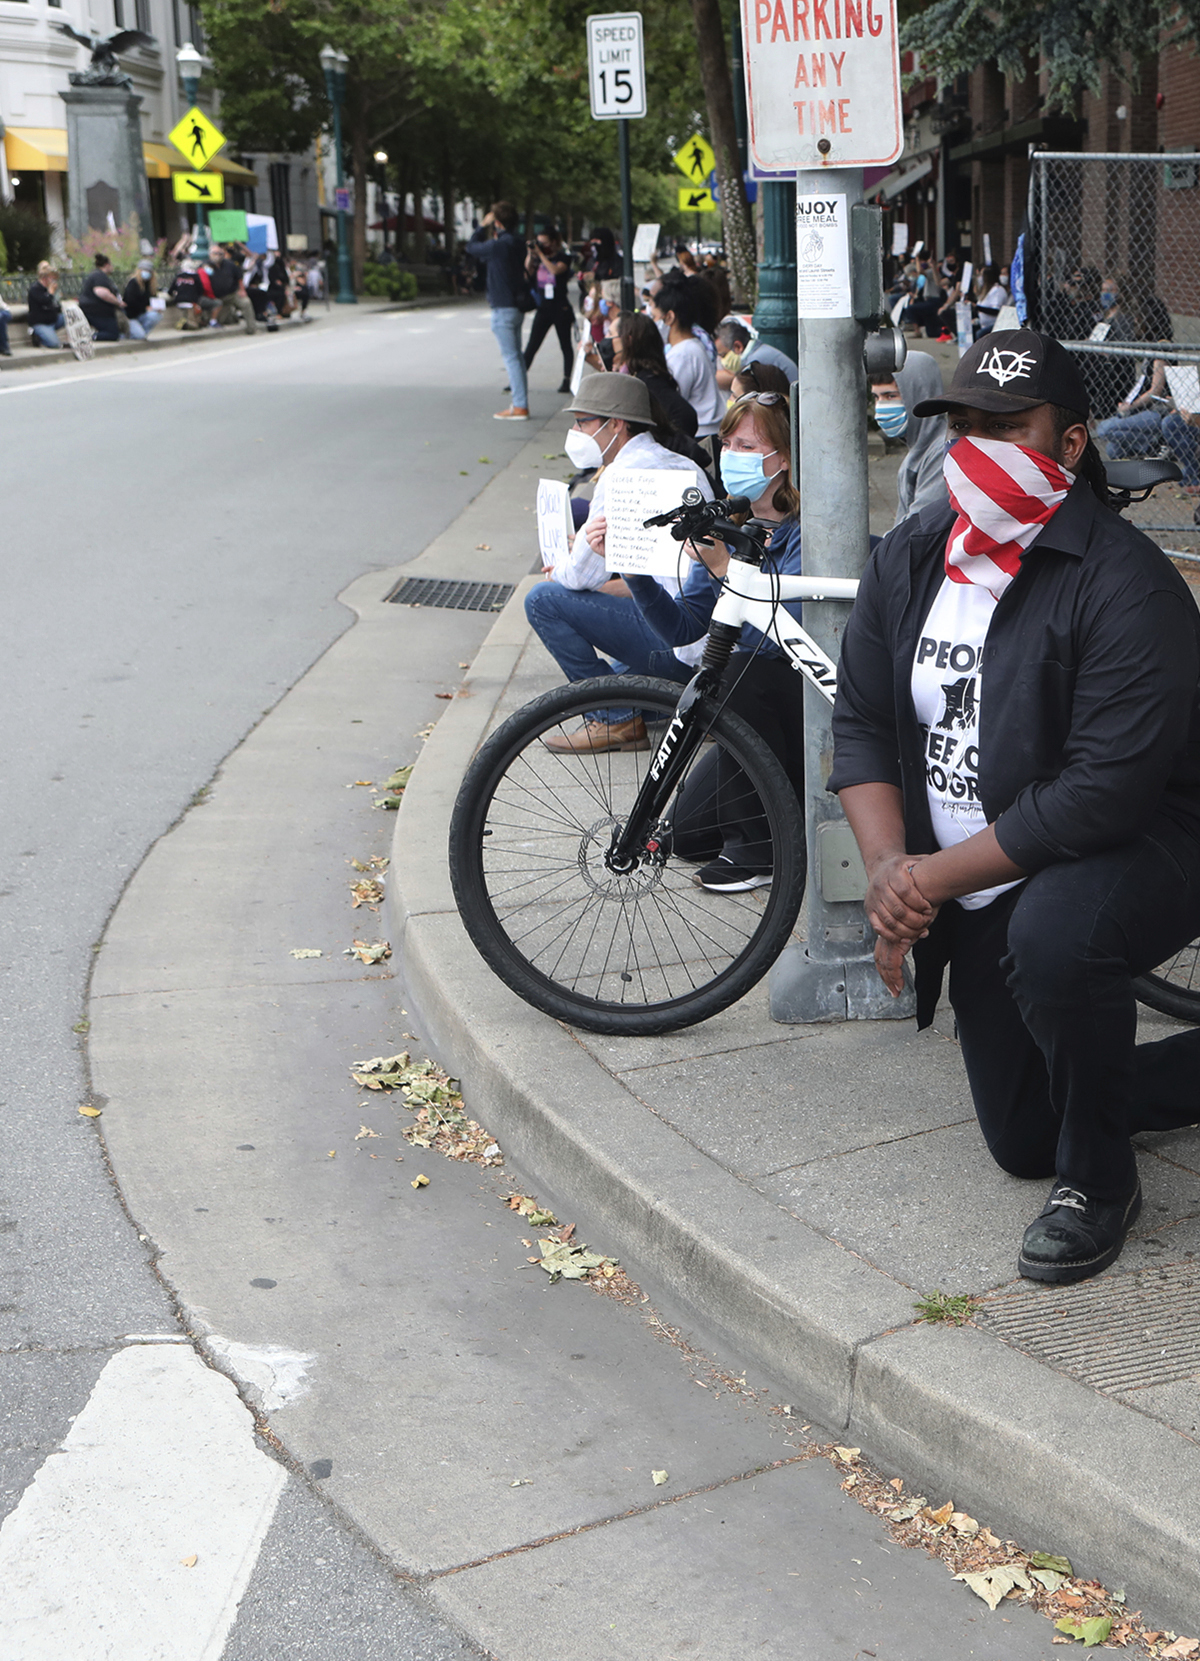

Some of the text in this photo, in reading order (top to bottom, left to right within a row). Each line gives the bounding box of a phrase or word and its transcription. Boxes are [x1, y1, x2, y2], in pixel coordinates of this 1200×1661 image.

[595, 26, 636, 42] SPEED
[755, 0, 883, 43] PARKING
[599, 48, 631, 63] LIMIT
[794, 51, 846, 88] ANY
[599, 69, 633, 104] 15
[793, 98, 852, 135] TIME
[812, 214, 838, 223] MEAL
[650, 708, 684, 781] FATTY
